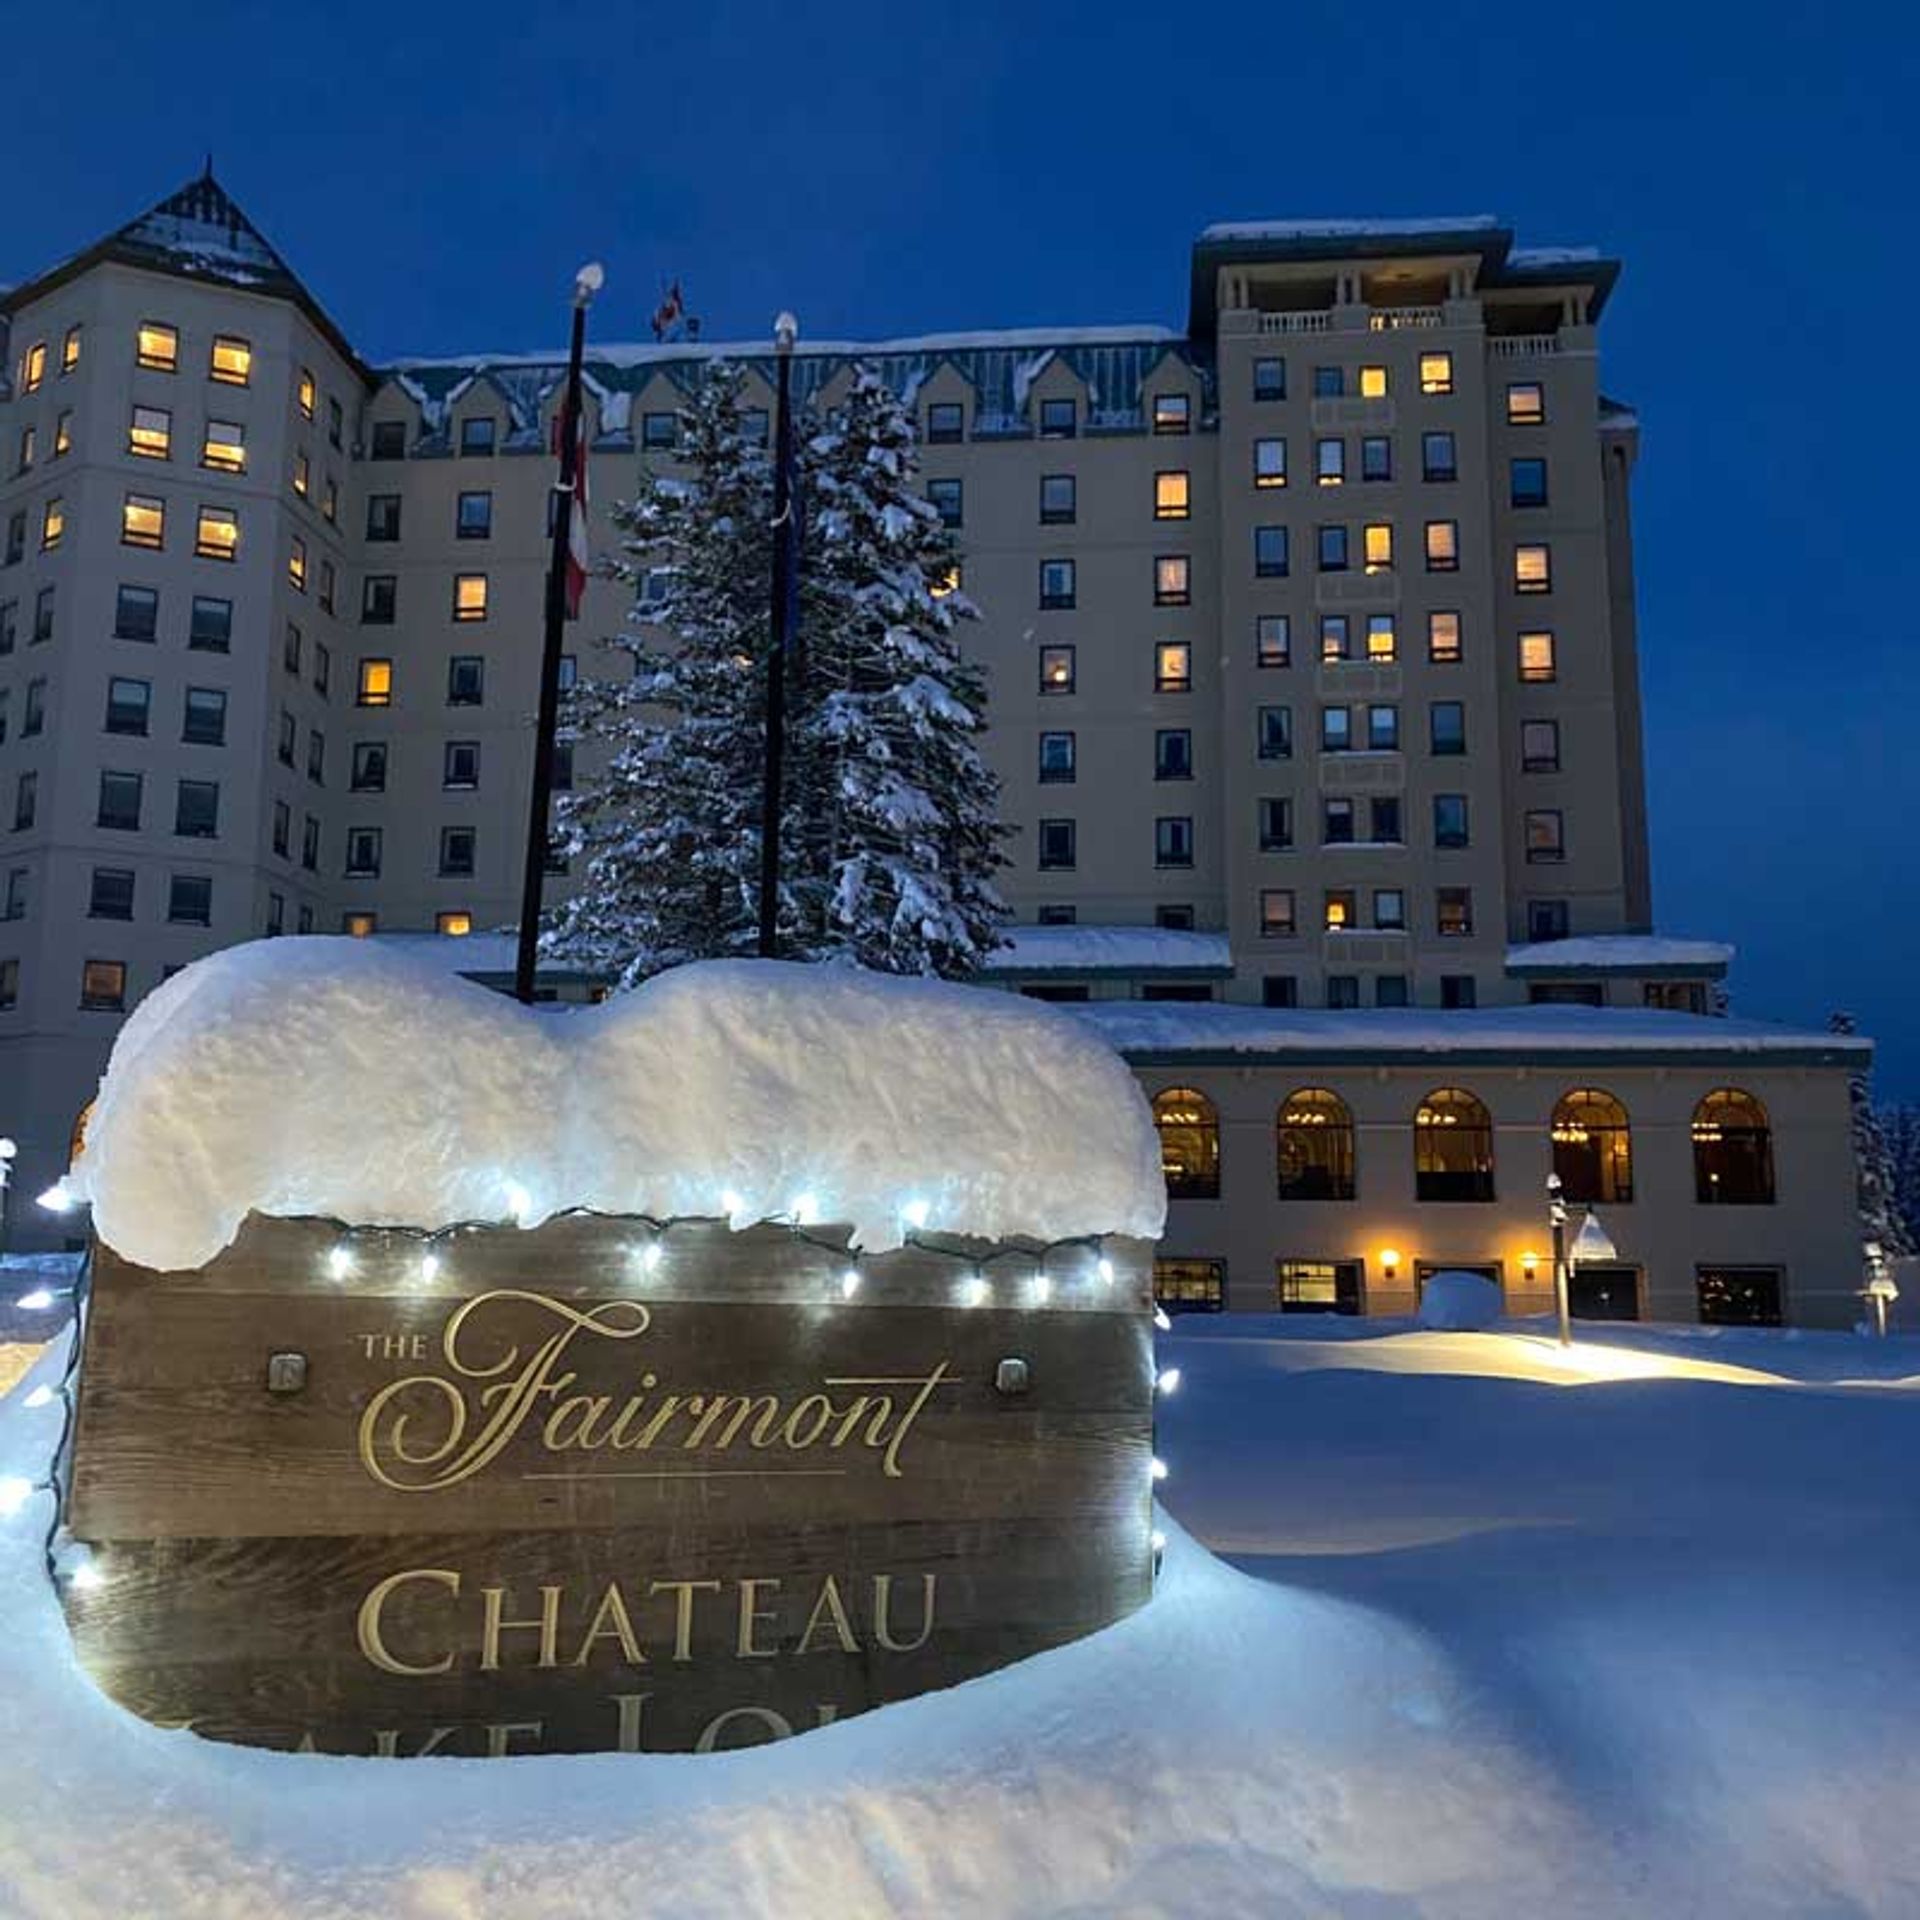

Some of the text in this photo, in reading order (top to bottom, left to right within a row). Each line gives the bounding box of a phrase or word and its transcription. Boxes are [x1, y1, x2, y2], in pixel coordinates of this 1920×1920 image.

[357, 1289, 962, 1492] THE Fairmont
[357, 1569, 936, 1676] CHATEAU
